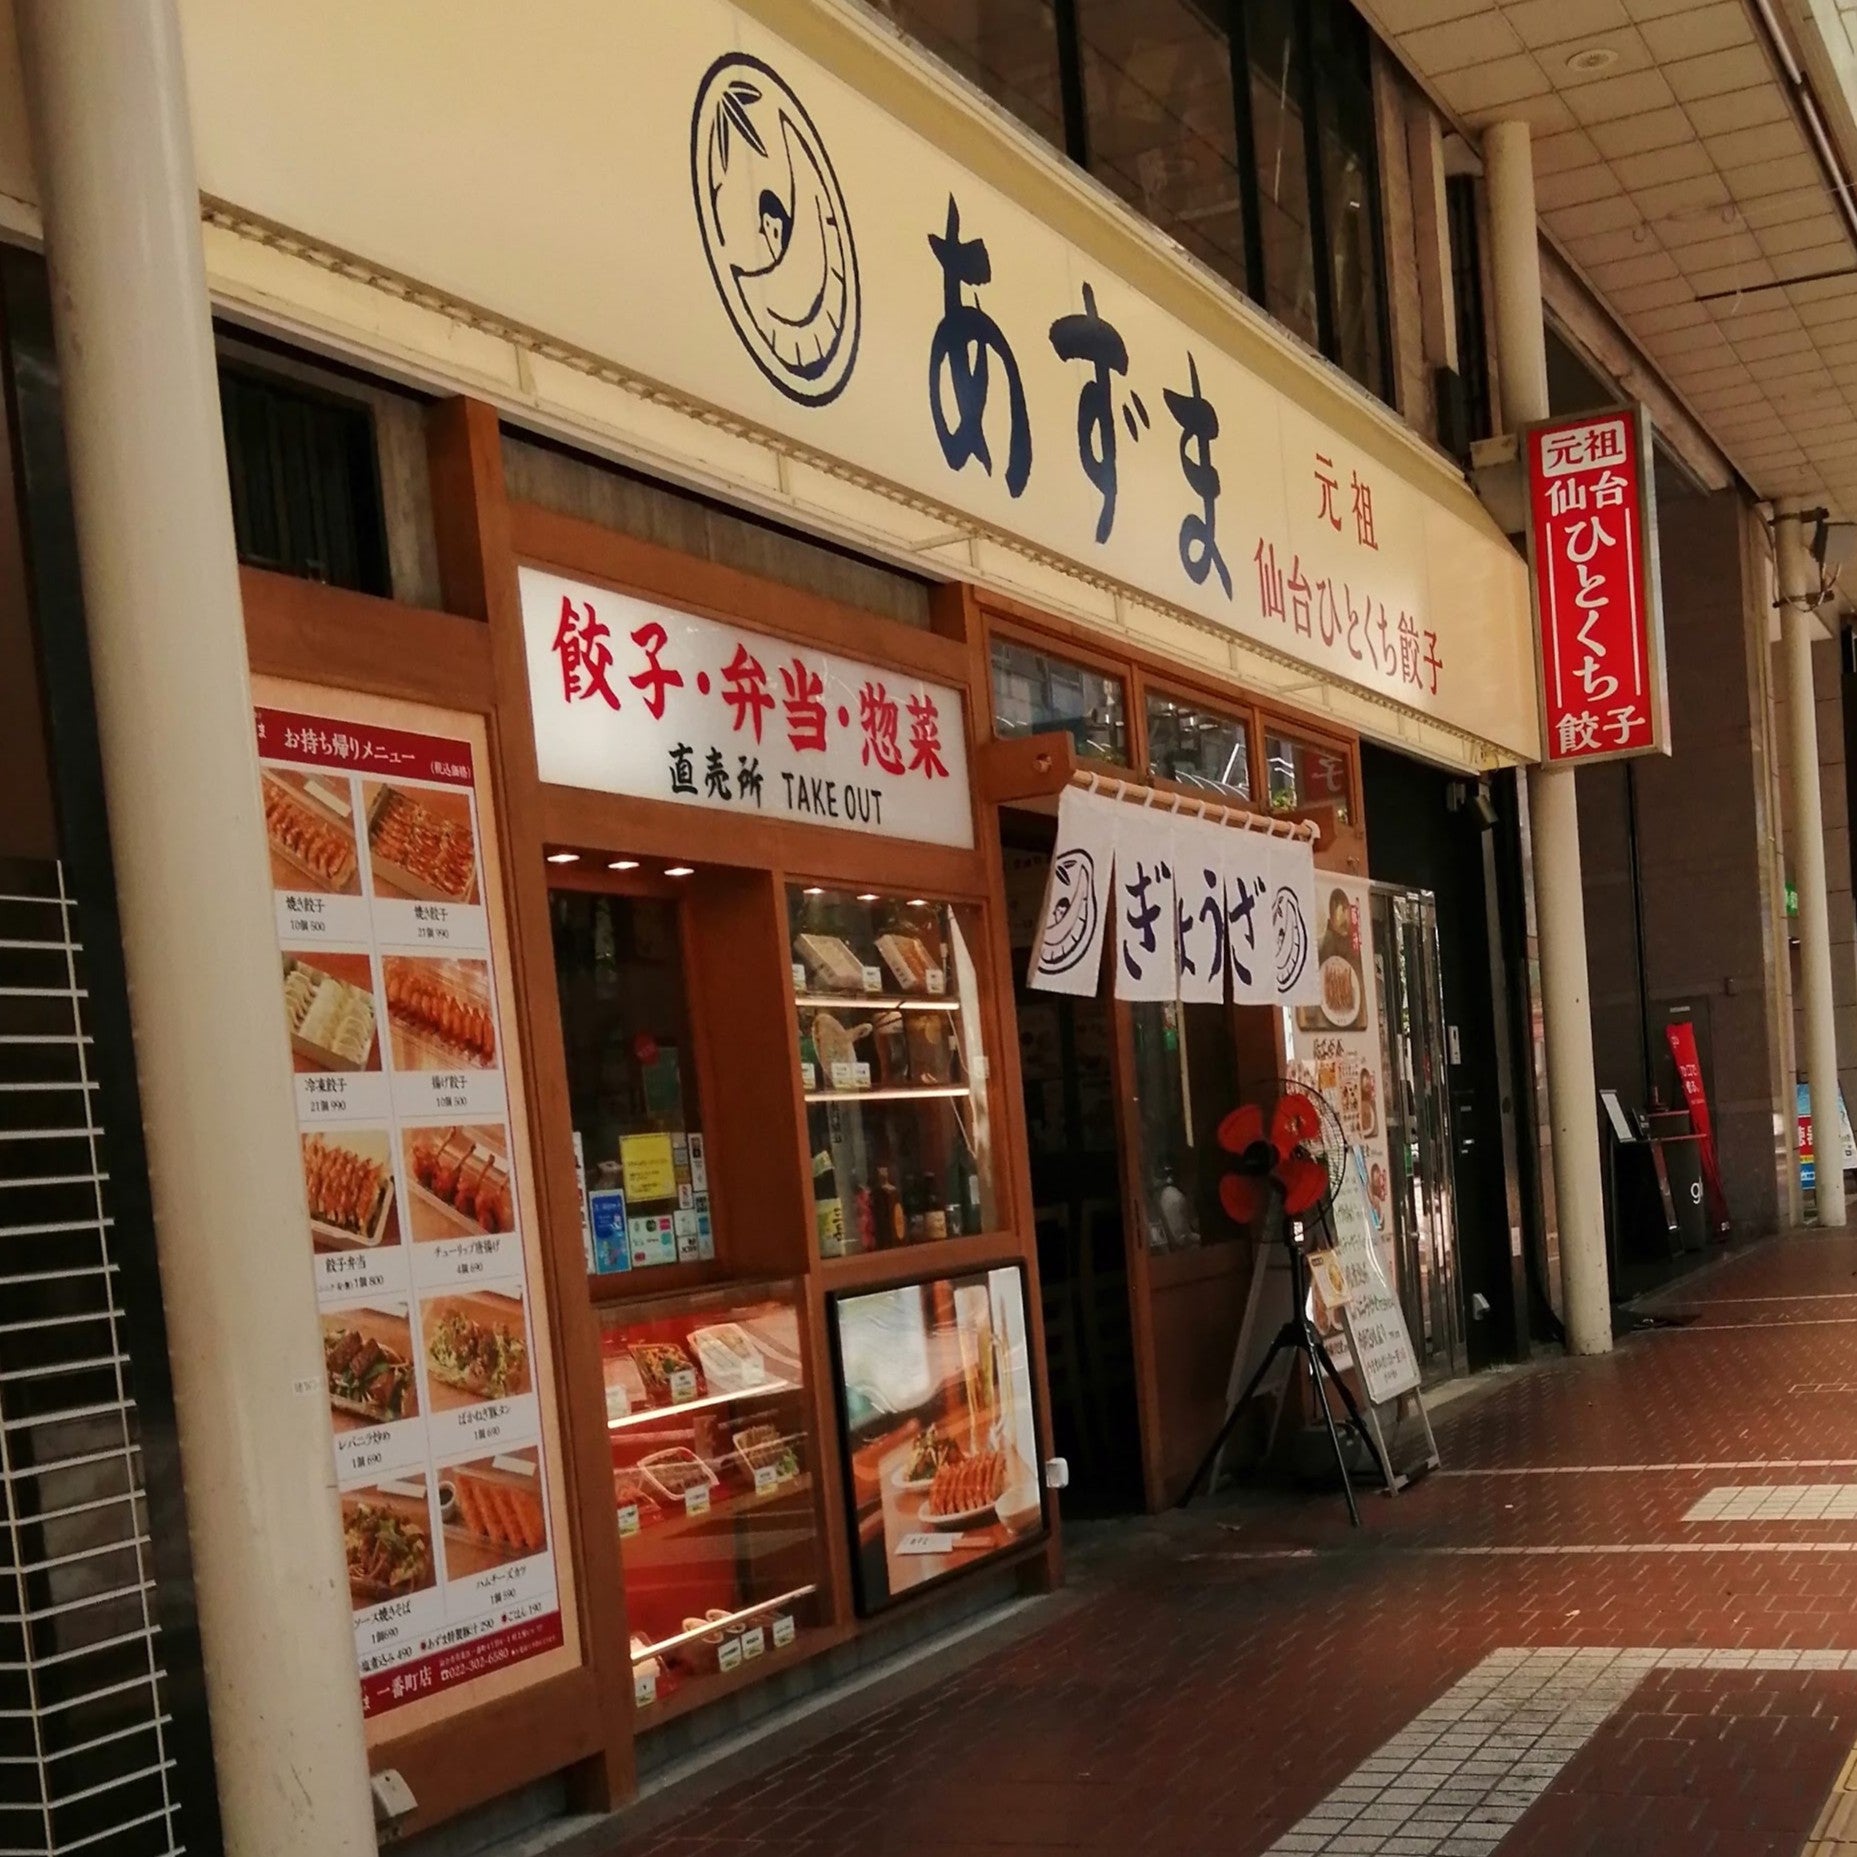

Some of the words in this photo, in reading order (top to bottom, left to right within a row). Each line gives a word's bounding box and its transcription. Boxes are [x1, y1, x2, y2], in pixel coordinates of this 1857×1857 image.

[928, 192, 1233, 601] あずま
[1546, 427, 1623, 469] 元祖
[1313, 452, 1379, 551] 元祖
[1545, 470, 1629, 517] 仙台
[1253, 537, 1443, 696] 仙台ひとくち餃子
[1564, 516, 1619, 702] ひとくち
[284, 727, 416, 763] お持ち帰りメニュー
[1555, 705, 1646, 754] 餃子
[668, 741, 766, 809] 直売所
[781, 772, 839, 818] TAKE
[844, 784, 882, 825] OUT
[304, 1078, 347, 1094] 冷凍餃子
[325, 1254, 367, 1274] 餃子弁当
[376, 1666, 433, 1700] 一番町店
